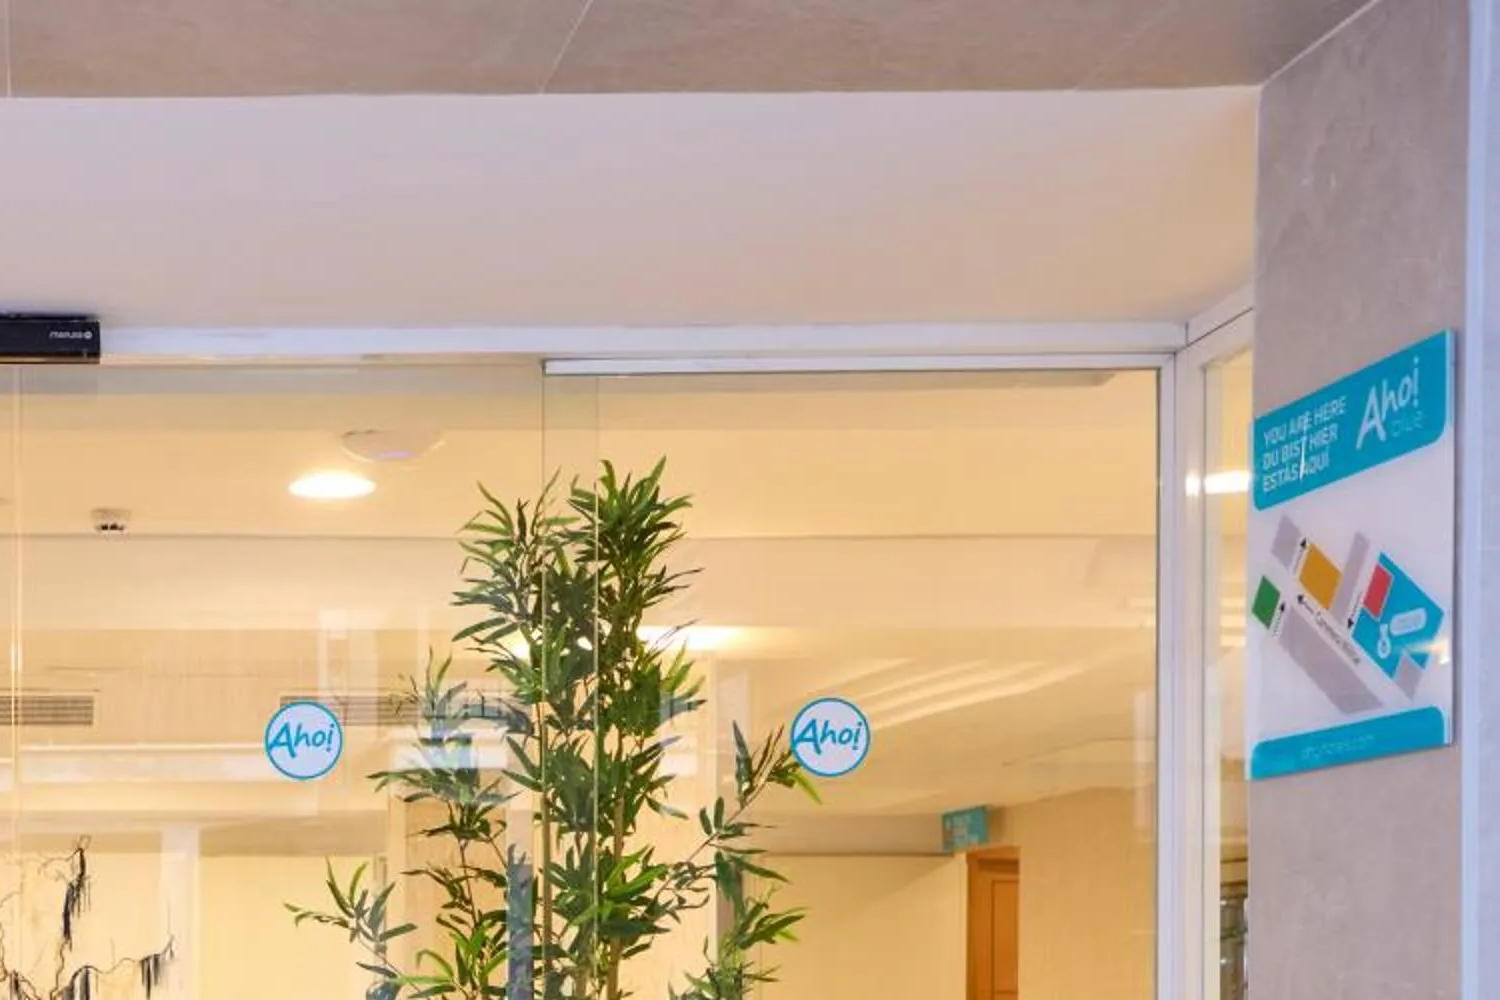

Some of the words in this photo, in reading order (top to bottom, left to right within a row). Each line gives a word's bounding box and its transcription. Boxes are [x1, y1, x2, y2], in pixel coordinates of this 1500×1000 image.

[1263, 423, 1287, 448] YOU
[1289, 410, 1312, 435] ARE
[1314, 395, 1347, 426] HERE
[1263, 449, 1279, 470] DU
[1281, 435, 1307, 463] BIST
[1309, 423, 1338, 452] HIER
